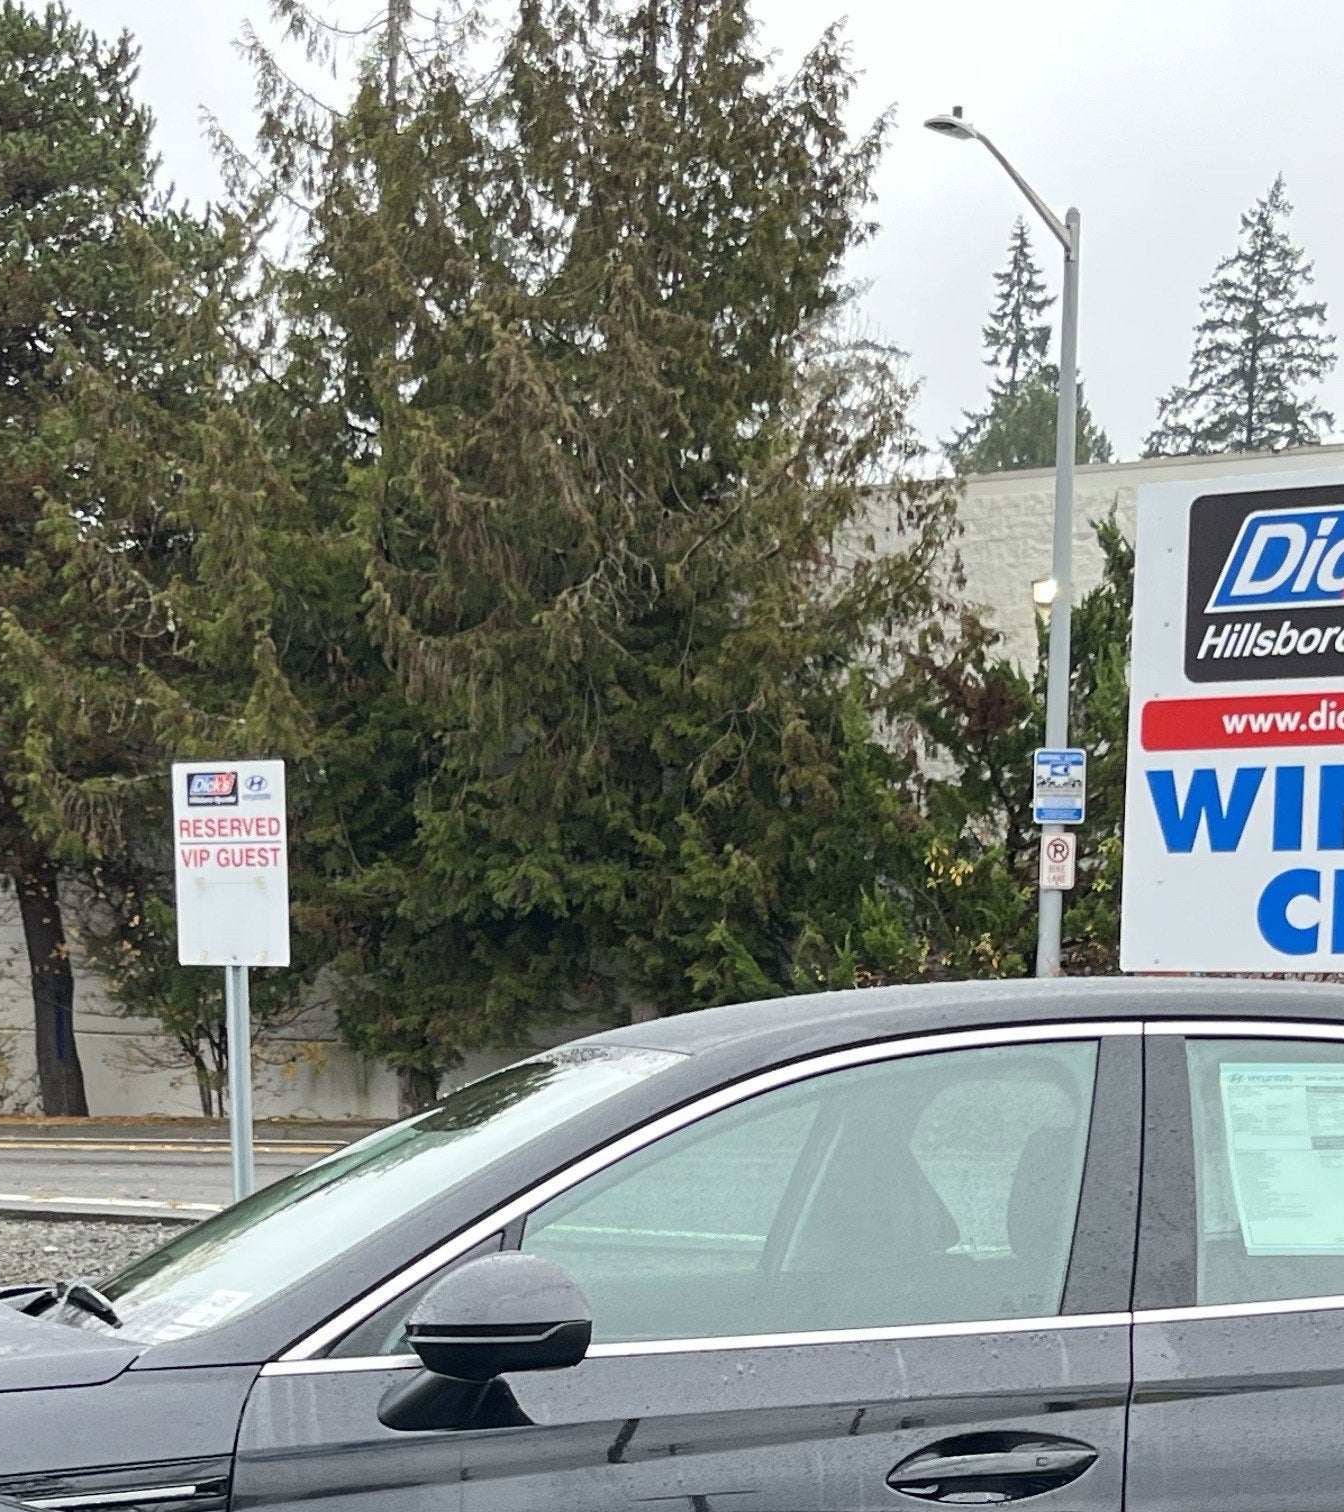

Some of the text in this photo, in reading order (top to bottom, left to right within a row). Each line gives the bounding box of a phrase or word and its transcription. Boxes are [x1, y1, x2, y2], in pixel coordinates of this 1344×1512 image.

[179, 817, 281, 838] RESERVED
[181, 847, 282, 868] VIP GUEST
